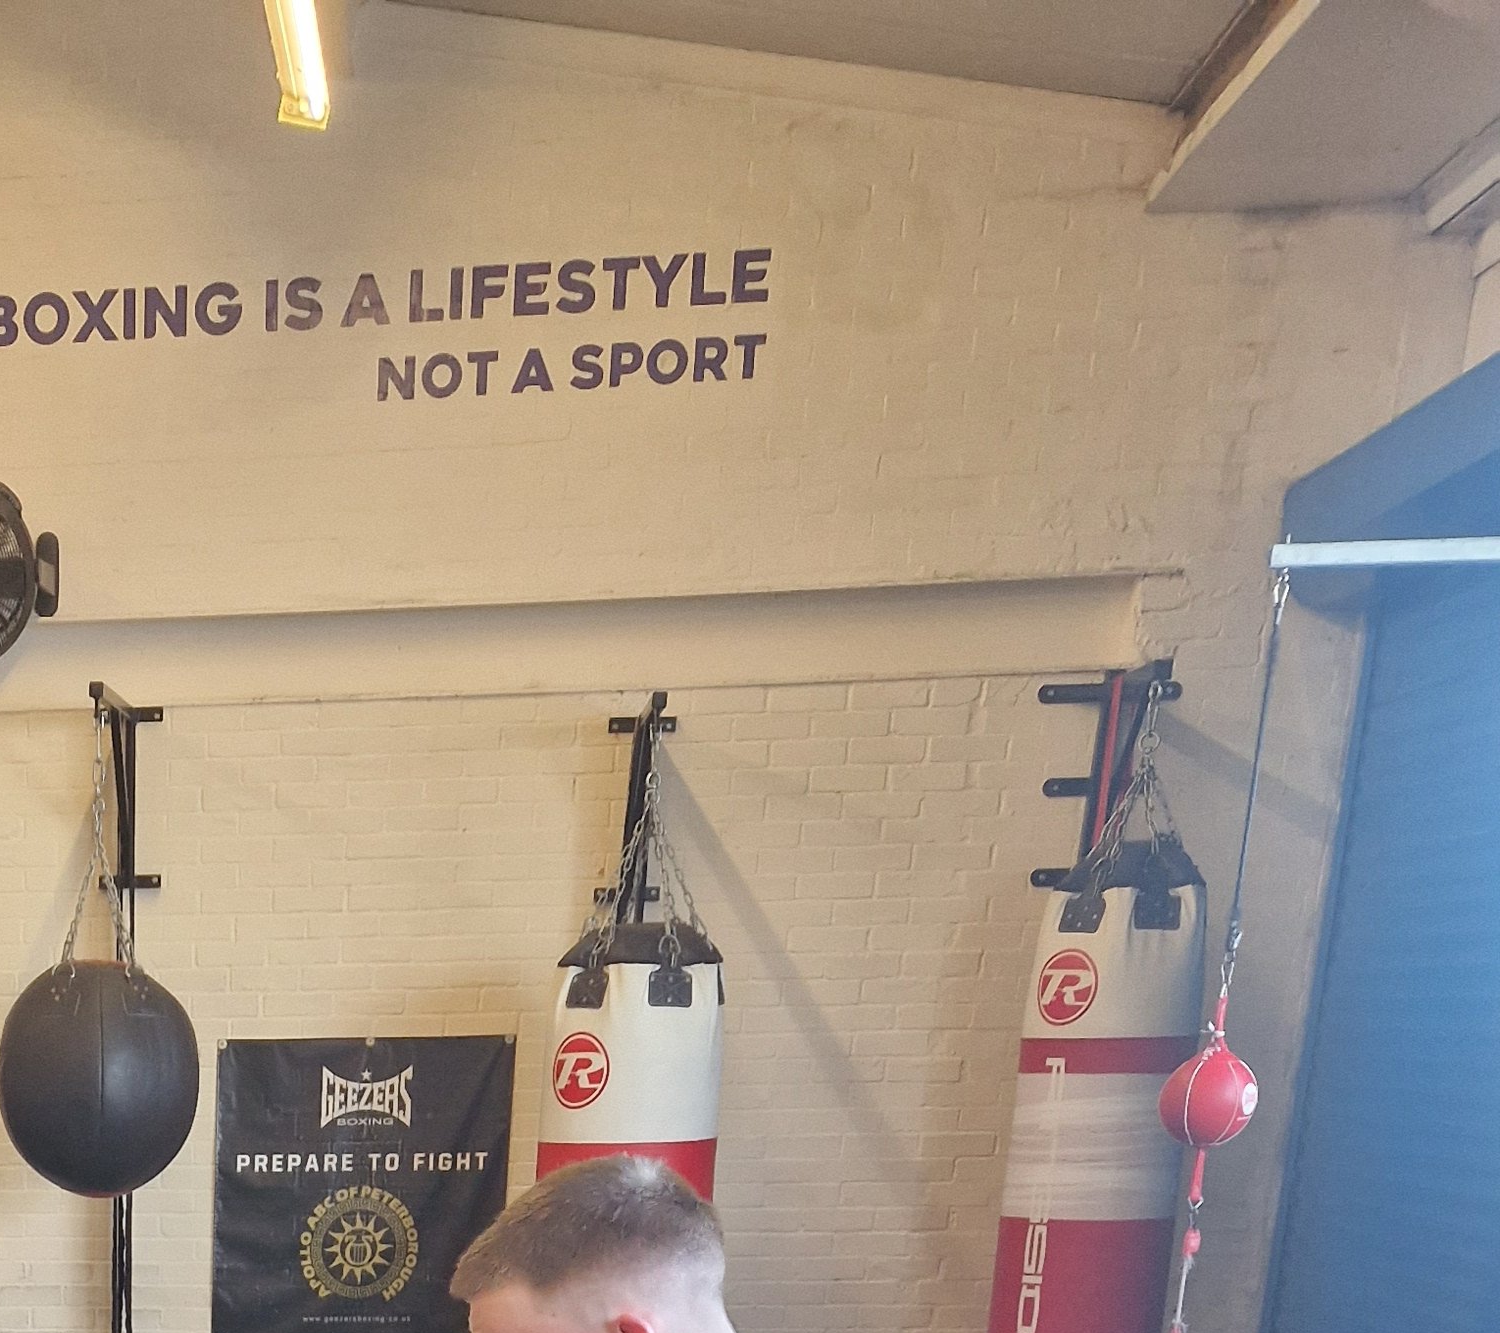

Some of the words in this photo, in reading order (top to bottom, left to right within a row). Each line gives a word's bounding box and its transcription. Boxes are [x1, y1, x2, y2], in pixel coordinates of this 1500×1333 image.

[264, 275, 324, 332] IS
[339, 272, 391, 327] A
[408, 248, 773, 322] LIFESTYLE
[376, 350, 499, 401] NOT
[510, 347, 554, 393] A
[570, 333, 768, 390] SPORT
[320, 1064, 414, 1129] GEEZERS
[336, 1117, 394, 1127] BOXING
[236, 1153, 354, 1173] PREPARE
[368, 1153, 400, 1172] TO
[413, 1151, 489, 1171] FIGHT
[334, 1186, 359, 1202] OF
[306, 1195, 336, 1231] ABC
[360, 1184, 419, 1302] PETERBOROUGH
[299, 1231, 333, 1299] APOLLO
